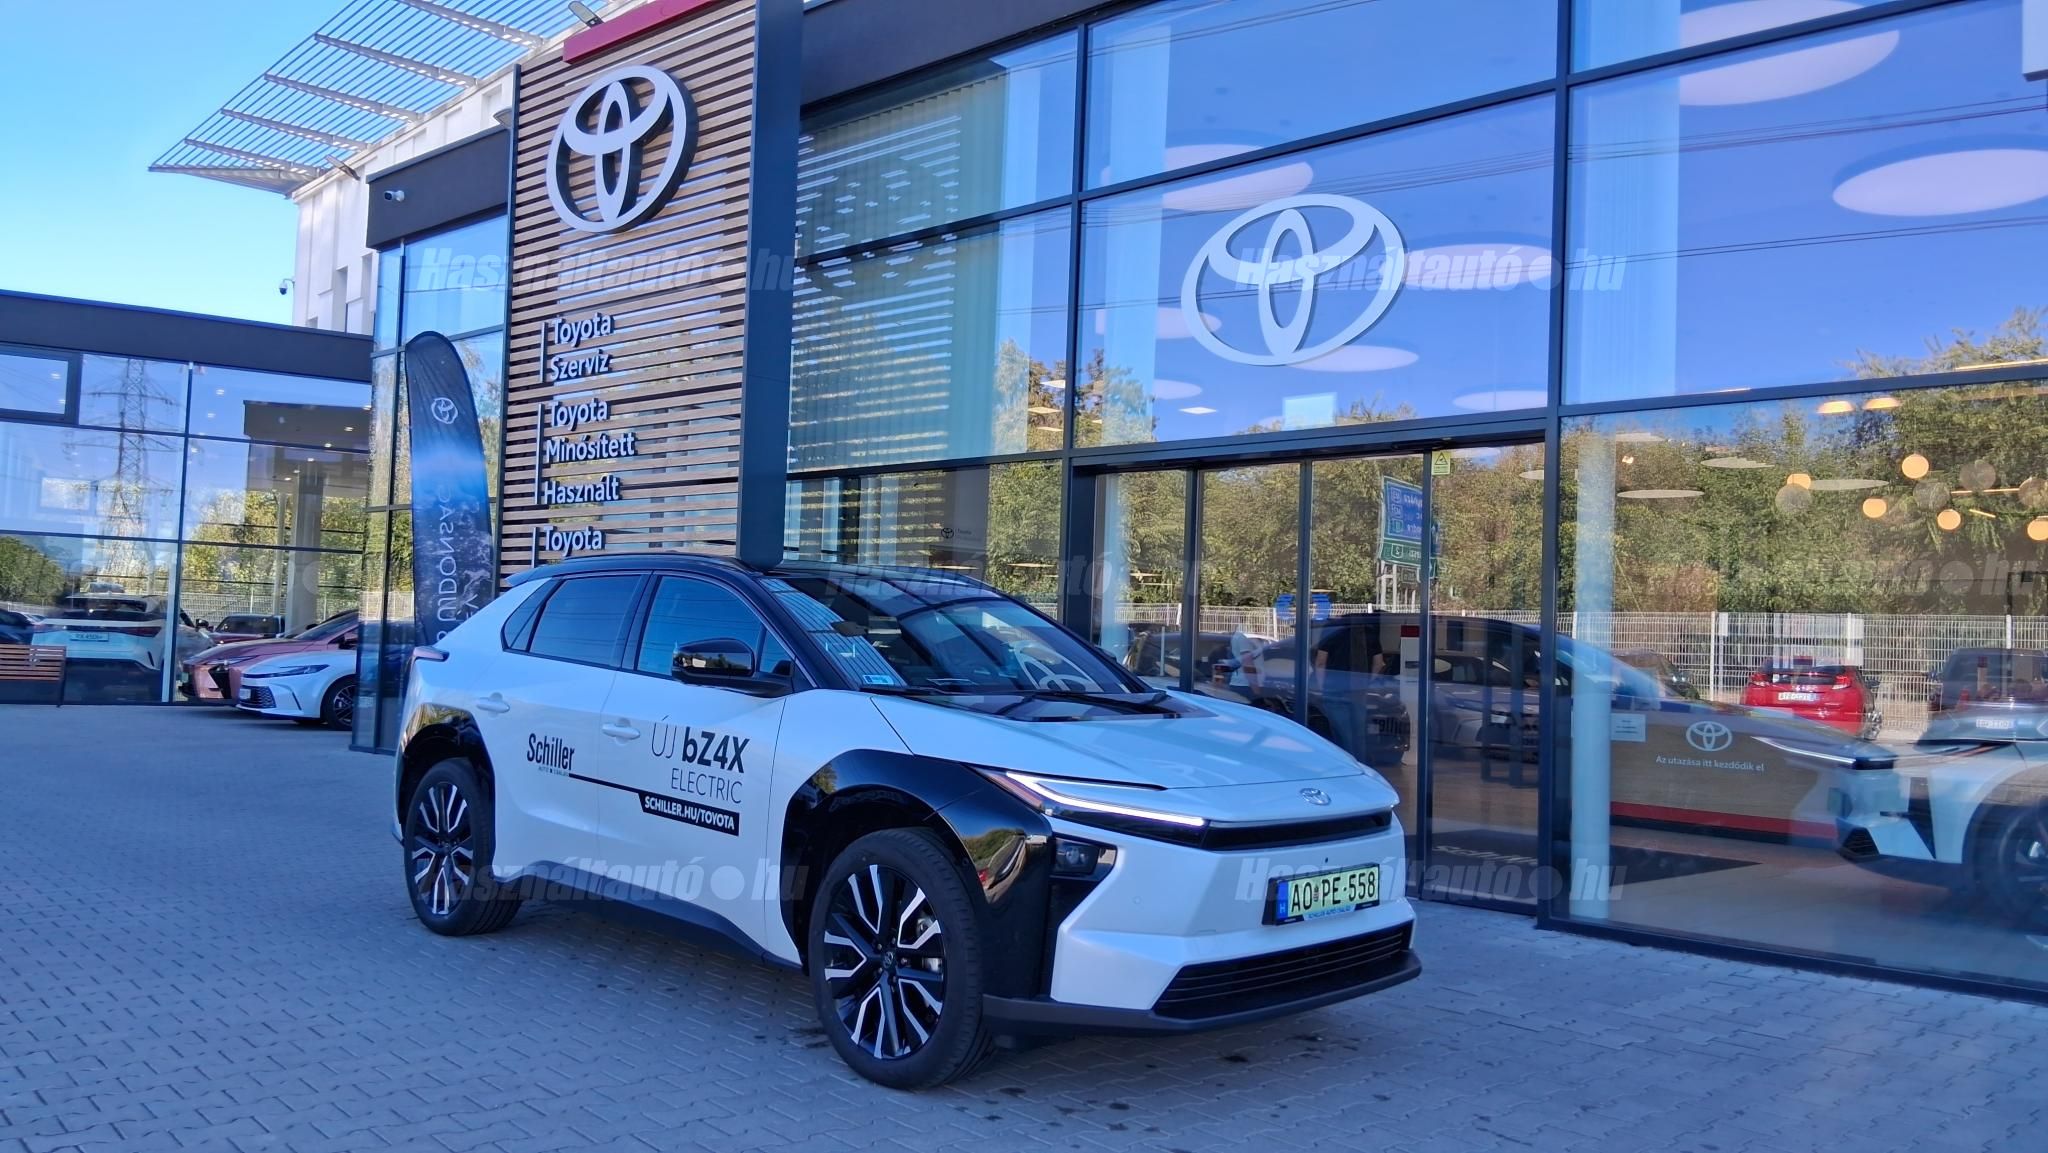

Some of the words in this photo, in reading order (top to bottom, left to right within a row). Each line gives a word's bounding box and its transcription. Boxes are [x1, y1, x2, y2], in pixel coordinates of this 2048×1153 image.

[553, 312, 612, 347] Toyota
[550, 349, 610, 380] Szerviz
[548, 399, 608, 431] Toyota
[546, 432, 635, 463] Minősített
[544, 475, 619, 504] Használt
[544, 525, 602, 557] Toyota
[527, 733, 575, 770] Schiller
[652, 715, 677, 759] ÚJ
[682, 727, 749, 773] bZ4X
[671, 768, 743, 804] ELECTRIC
[644, 795, 735, 831] SCHILLER.HU/TOYOTA
